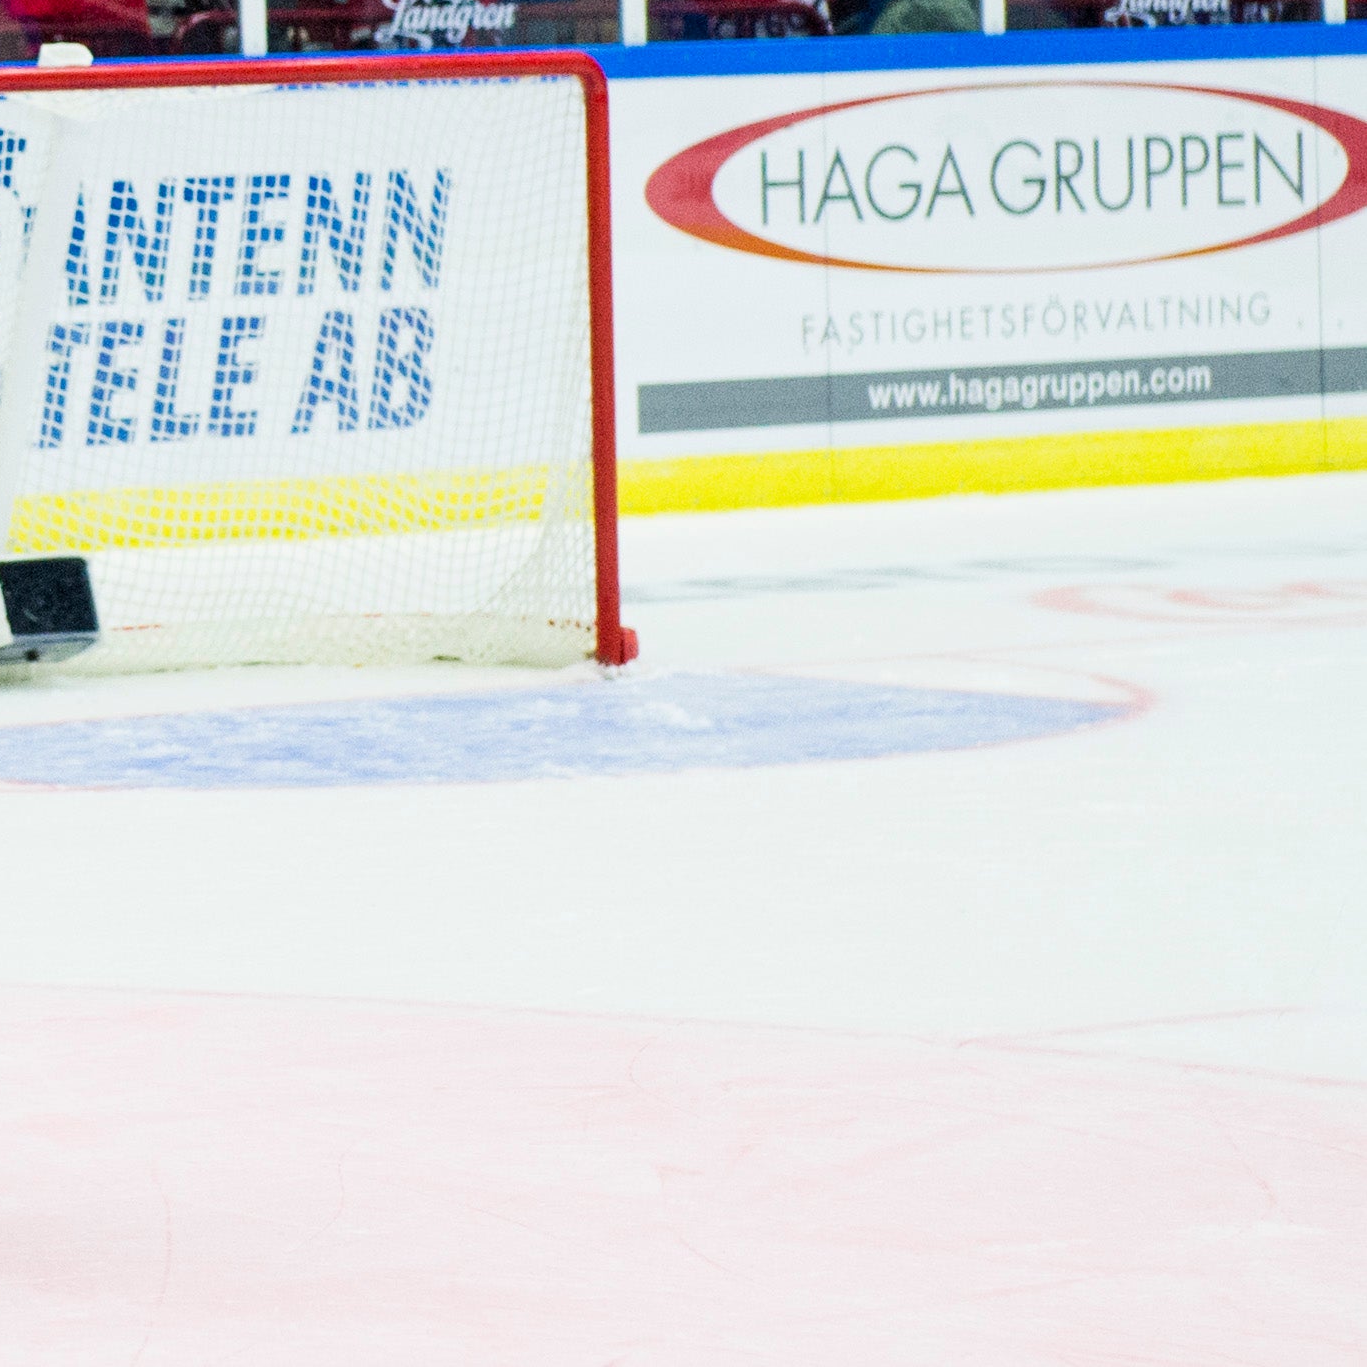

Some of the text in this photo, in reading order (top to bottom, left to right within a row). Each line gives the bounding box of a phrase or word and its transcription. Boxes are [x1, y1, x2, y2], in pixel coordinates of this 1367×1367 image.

[761, 131, 1306, 226] HAGA GRUPPEN
[801, 293, 1273, 353] FASTIGHETSFÖRVALTNING
[33, 307, 434, 448] TELE AB
[868, 363, 1212, 412] www.hagagruppen.com
